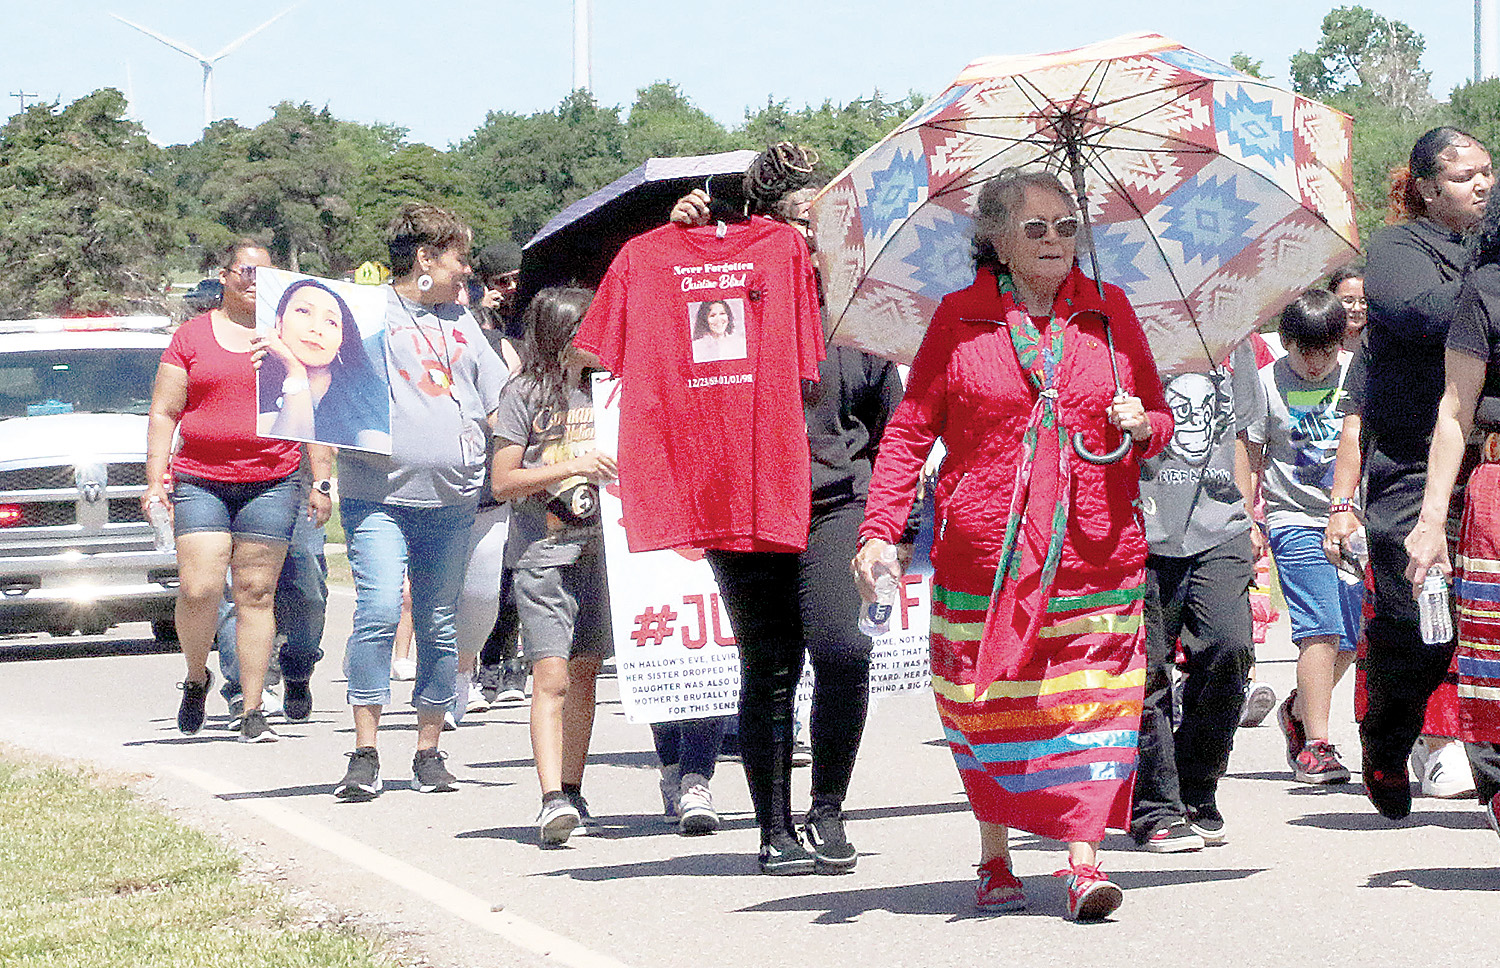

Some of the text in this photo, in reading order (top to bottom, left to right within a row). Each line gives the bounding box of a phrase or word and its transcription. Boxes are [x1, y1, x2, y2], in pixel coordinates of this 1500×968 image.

[673, 262, 754, 276] Never Forgotten
[623, 662, 636, 670] ON
[639, 657, 685, 668] HALLOW'S
[711, 652, 740, 663] ELVIR
[899, 635, 916, 645] NOT
[626, 673, 644, 682] HER
[647, 669, 679, 680] SISTER
[683, 666, 725, 677] DROPPED
[728, 664, 739, 673] HE
[870, 649, 899, 660] OWING
[902, 647, 922, 656] THAT
[632, 682, 681, 694] DAUGHTER
[684, 680, 704, 689] WAS
[707, 677, 730, 687] ALSO
[870, 661, 890, 671] ATH.
[903, 659, 921, 668] WAS
[635, 694, 681, 706] MOTHER'S
[683, 690, 729, 701] BRUTALLY
[870, 672, 901, 682] KYARD.
[903, 670, 921, 679] HER
[668, 706, 687, 715] FOR
[690, 703, 710, 713] THIS
[713, 701, 736, 711] SENS
[870, 684, 897, 694] EHIND
